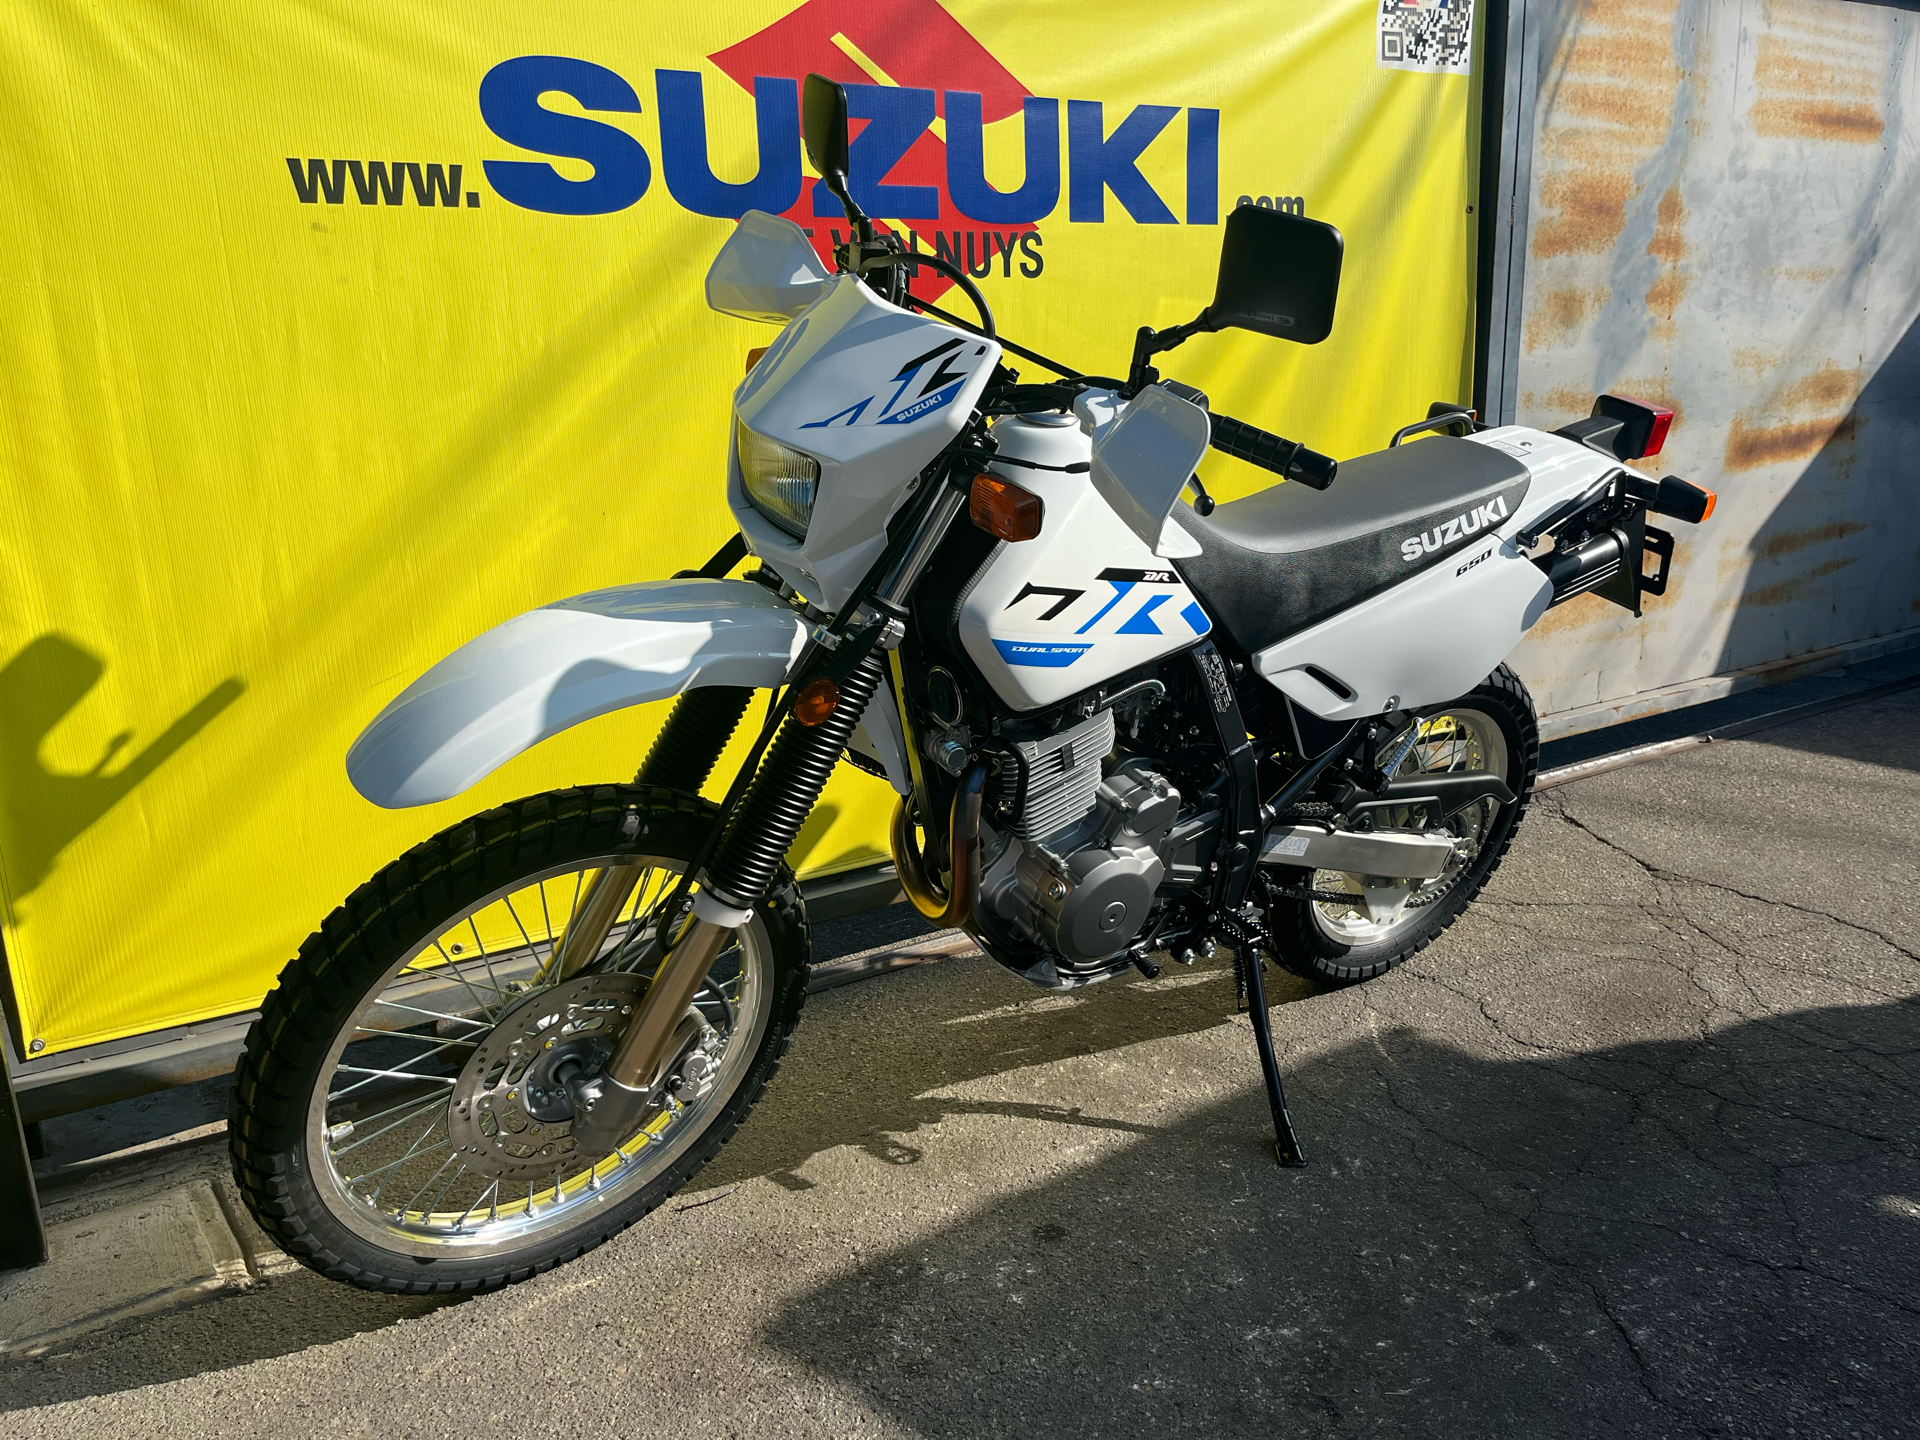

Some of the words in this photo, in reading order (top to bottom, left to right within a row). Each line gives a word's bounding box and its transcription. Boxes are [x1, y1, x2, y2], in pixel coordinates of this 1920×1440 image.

[936, 230, 1044, 279] NUYS
[896, 394, 943, 422] SUZUKI
[1400, 495, 1508, 562] SUZUKI
[1456, 547, 1493, 577] 650
